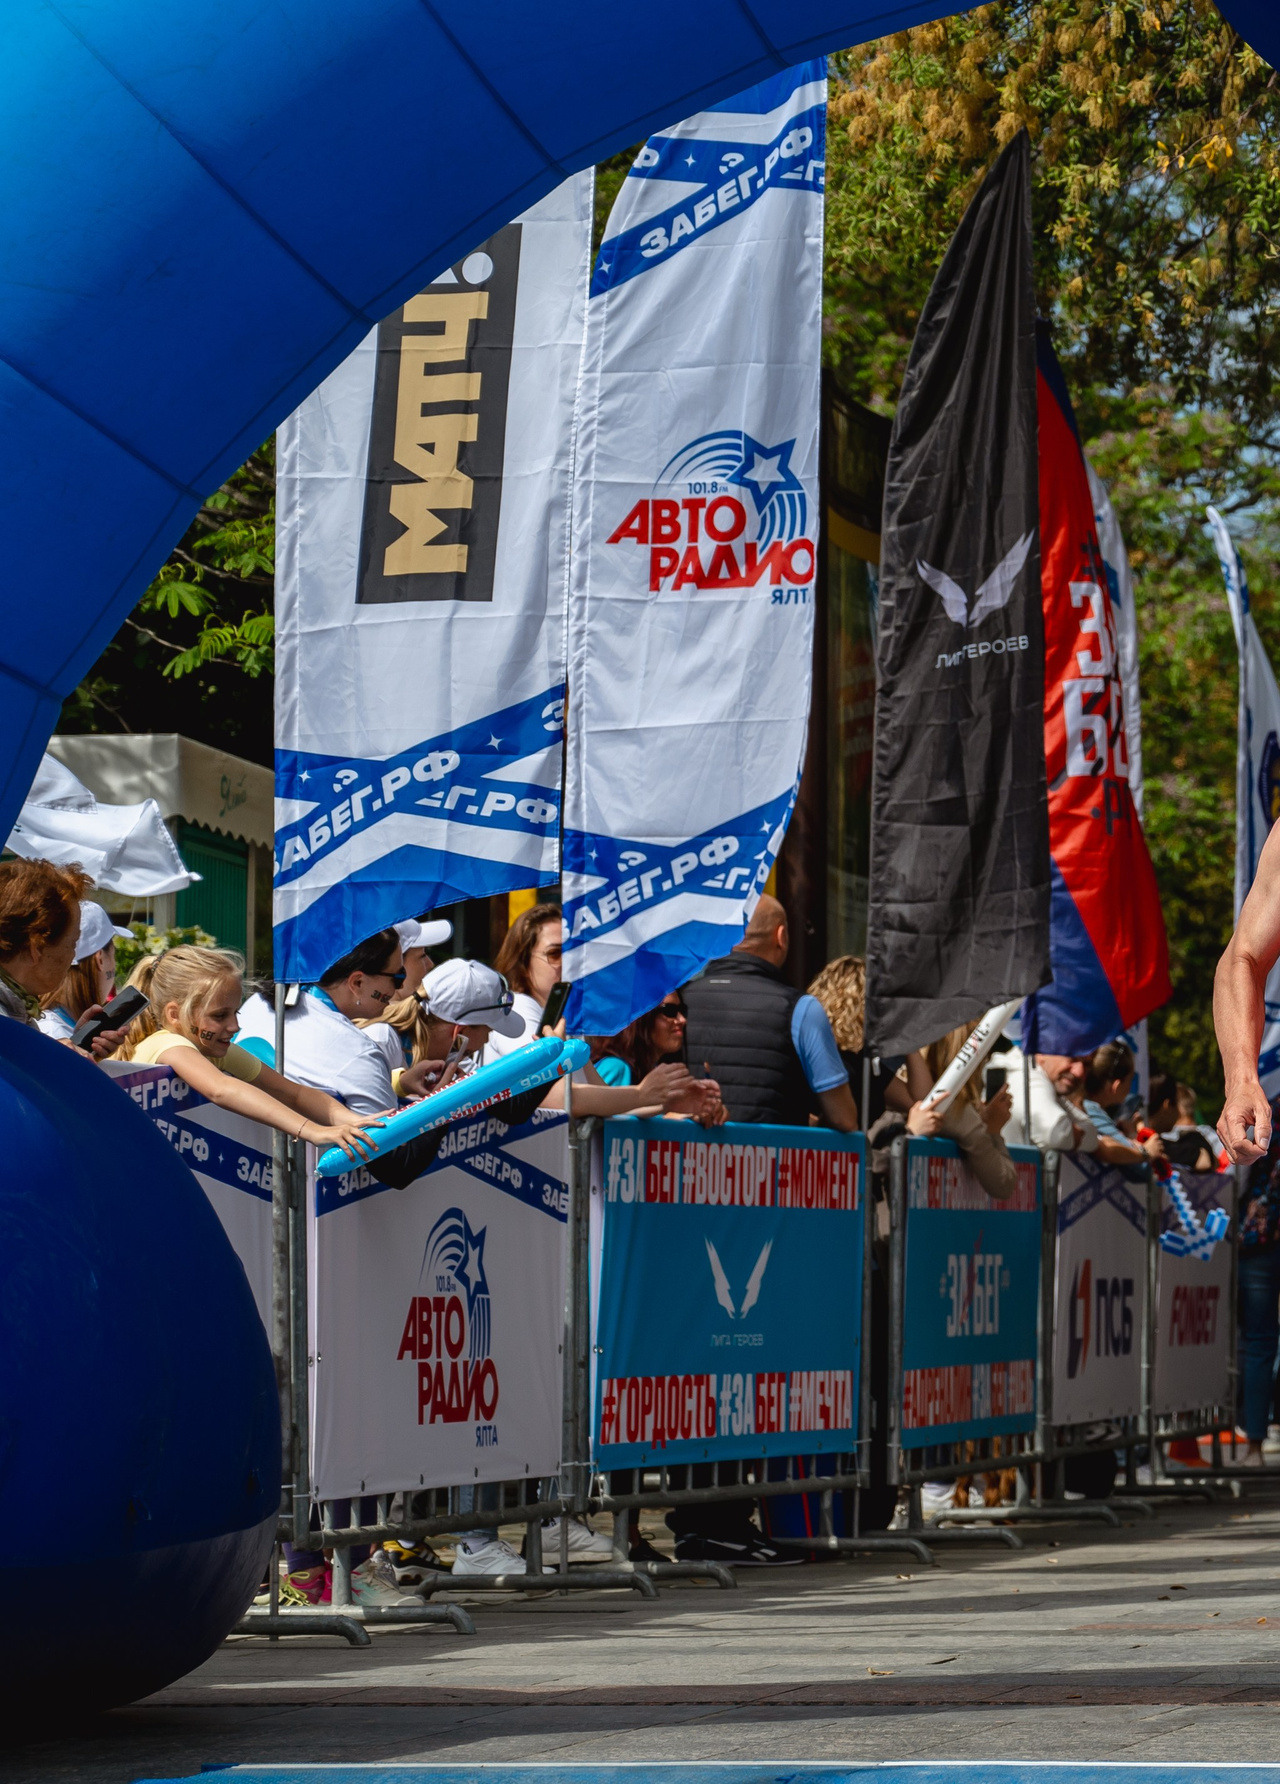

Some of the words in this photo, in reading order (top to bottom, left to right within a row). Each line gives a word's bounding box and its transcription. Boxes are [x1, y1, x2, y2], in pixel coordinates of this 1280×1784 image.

[640, 126, 813, 258] ЗАБЕГ.РФ
[688, 481, 718, 495] 101.8
[605, 495, 747, 545] АВТО
[649, 538, 815, 592] РАДИО
[771, 588, 811, 605] ЯЛТ
[273, 749, 460, 878] АБЕГ.РФ
[683, 1141, 777, 1207] #ВОСТОРГ
[777, 1147, 860, 1210] #МОМЕНТ
[435, 1275, 450, 1293] 101.8
[397, 1295, 465, 1361] АВТО
[710, 1334, 732, 1346] ЛИГА
[733, 1333, 764, 1346] ГЕРОЕВ
[1096, 1277, 1134, 1358] ПСБ
[417, 1358, 499, 1425] РАДИО
[600, 1373, 717, 1449] #ГОРДОСТЬ
[789, 1370, 854, 1432] #МЕЧТА
[475, 1425, 499, 1448] ЯЛТА
